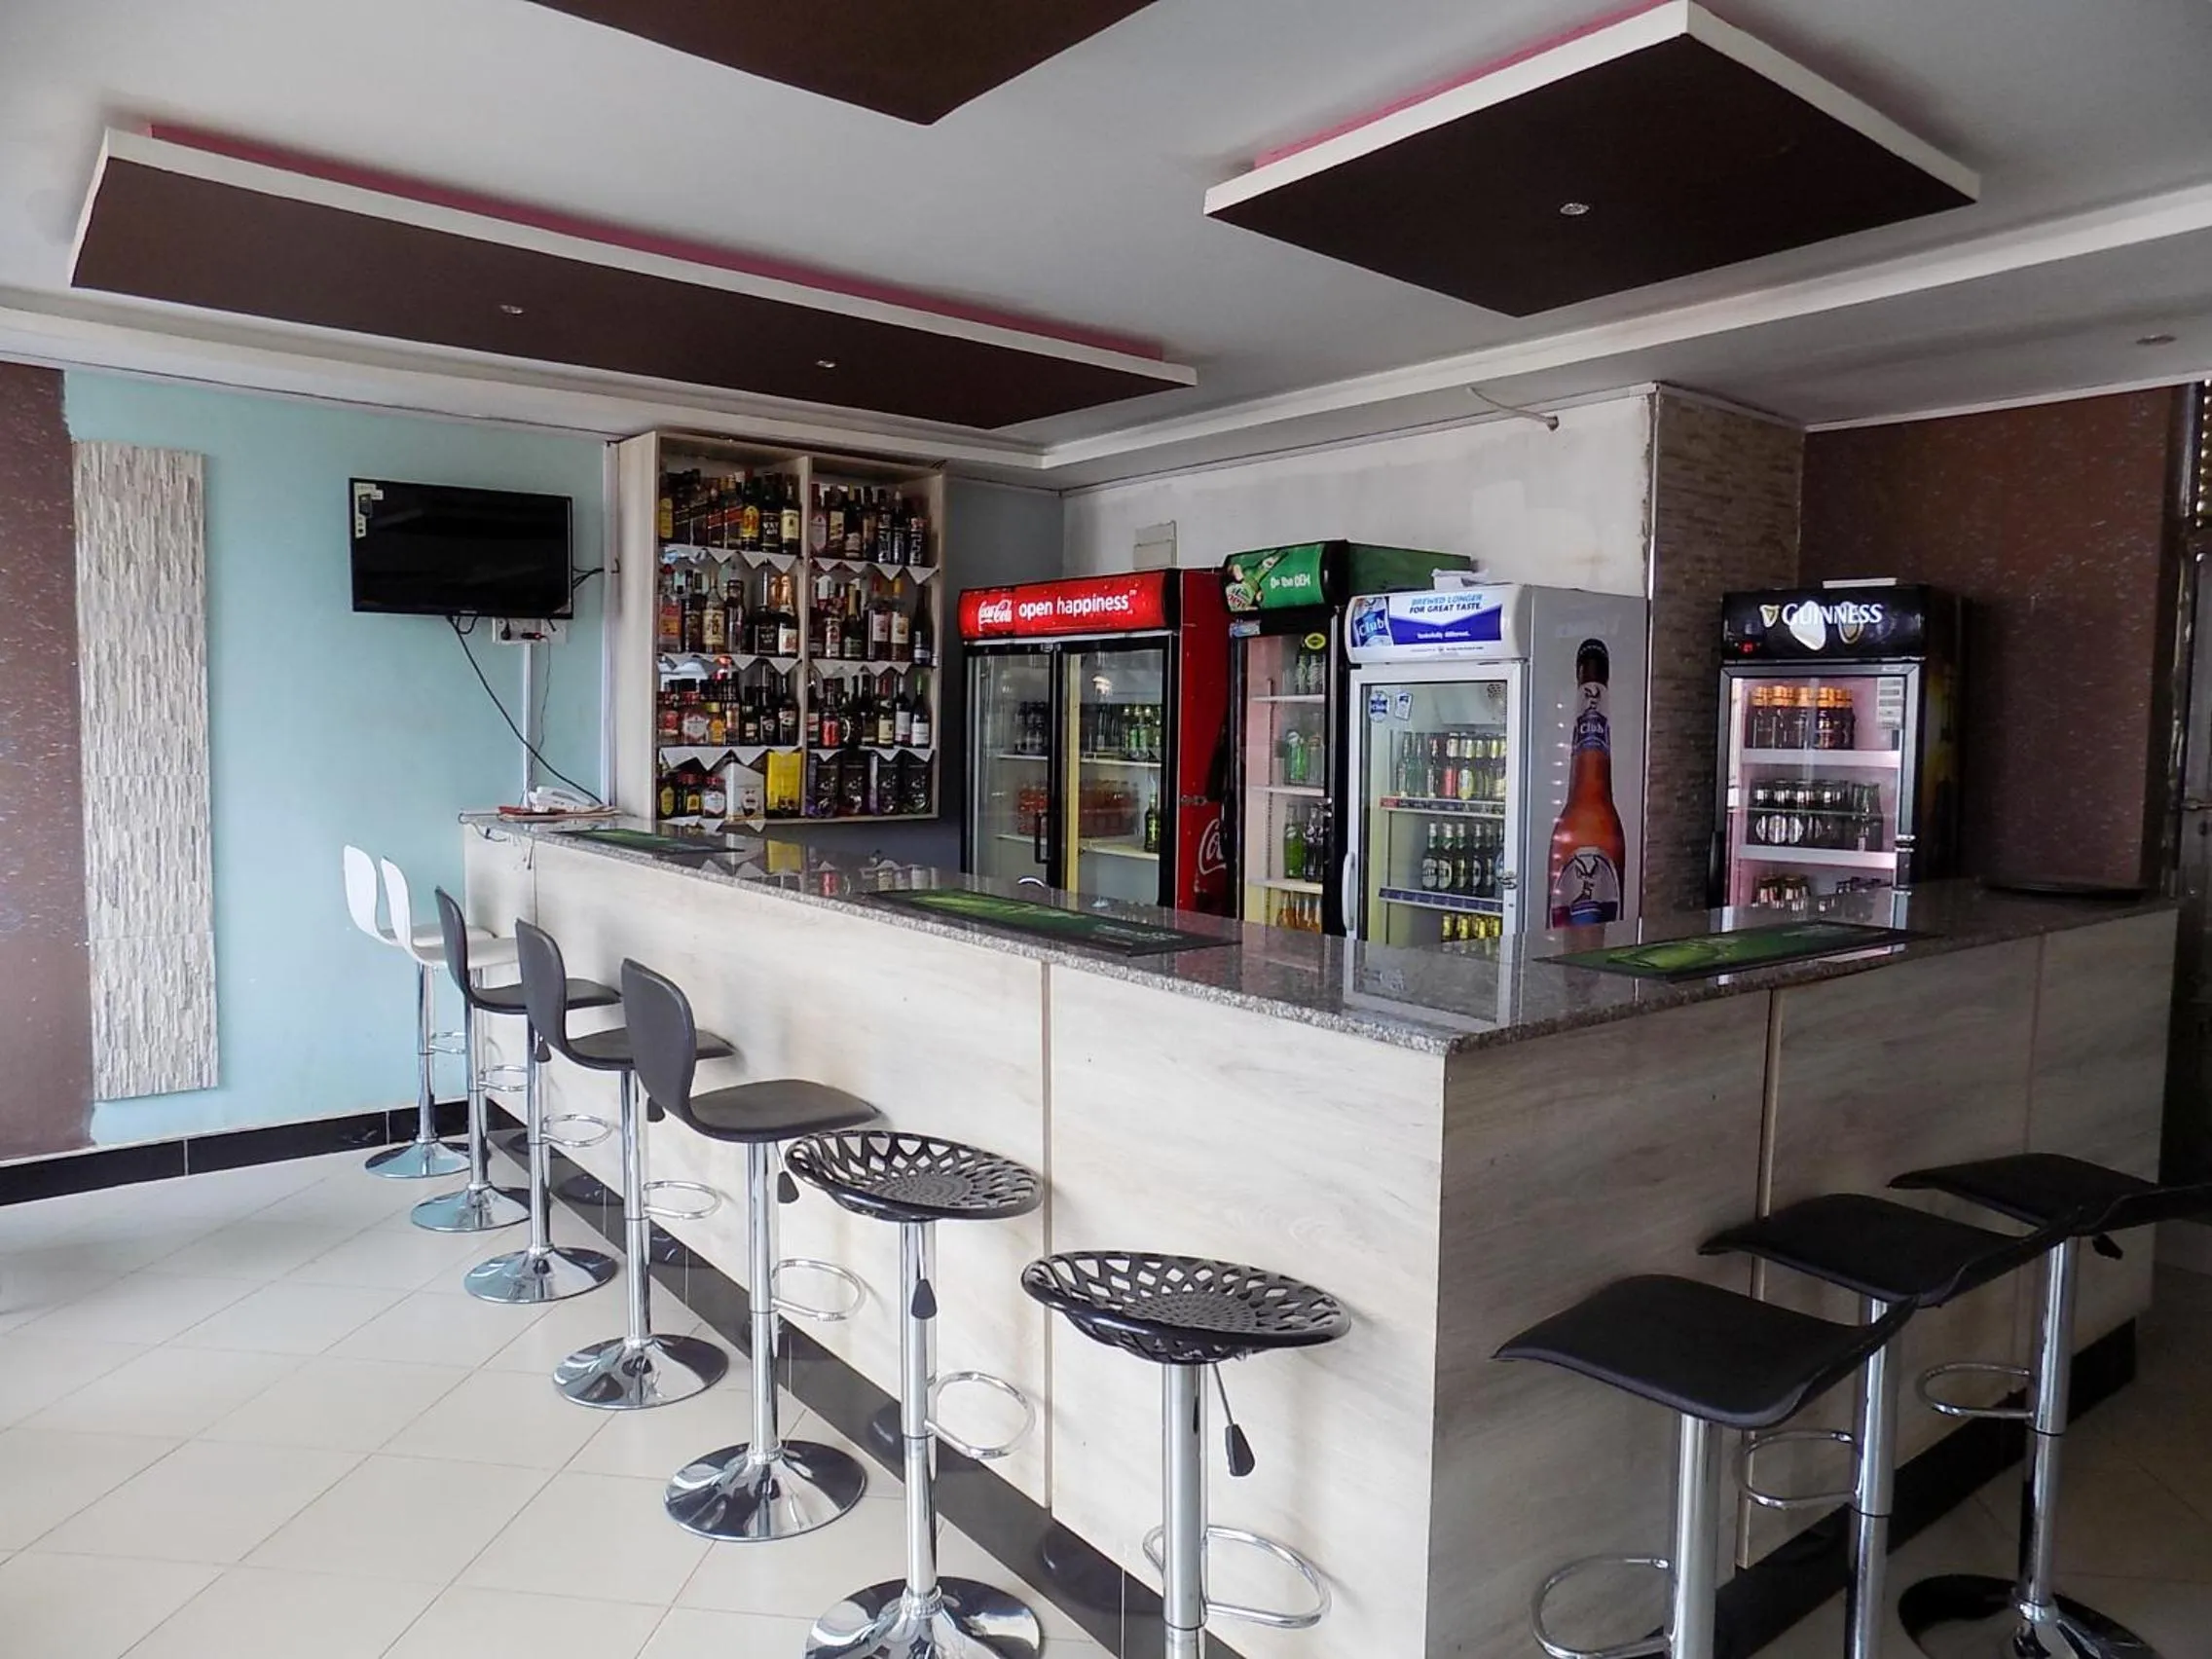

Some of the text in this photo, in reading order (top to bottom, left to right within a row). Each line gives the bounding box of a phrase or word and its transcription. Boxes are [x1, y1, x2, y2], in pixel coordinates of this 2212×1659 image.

[1412, 593, 1484, 606] BREWED LONGER
[1018, 601, 1053, 620] open
[1409, 606, 1425, 614] FOR
[1426, 604, 1455, 613] GREAT
[1782, 603, 1884, 626] GUINNESS
[1358, 616, 1384, 637] Club
[1580, 721, 1604, 734] Club
